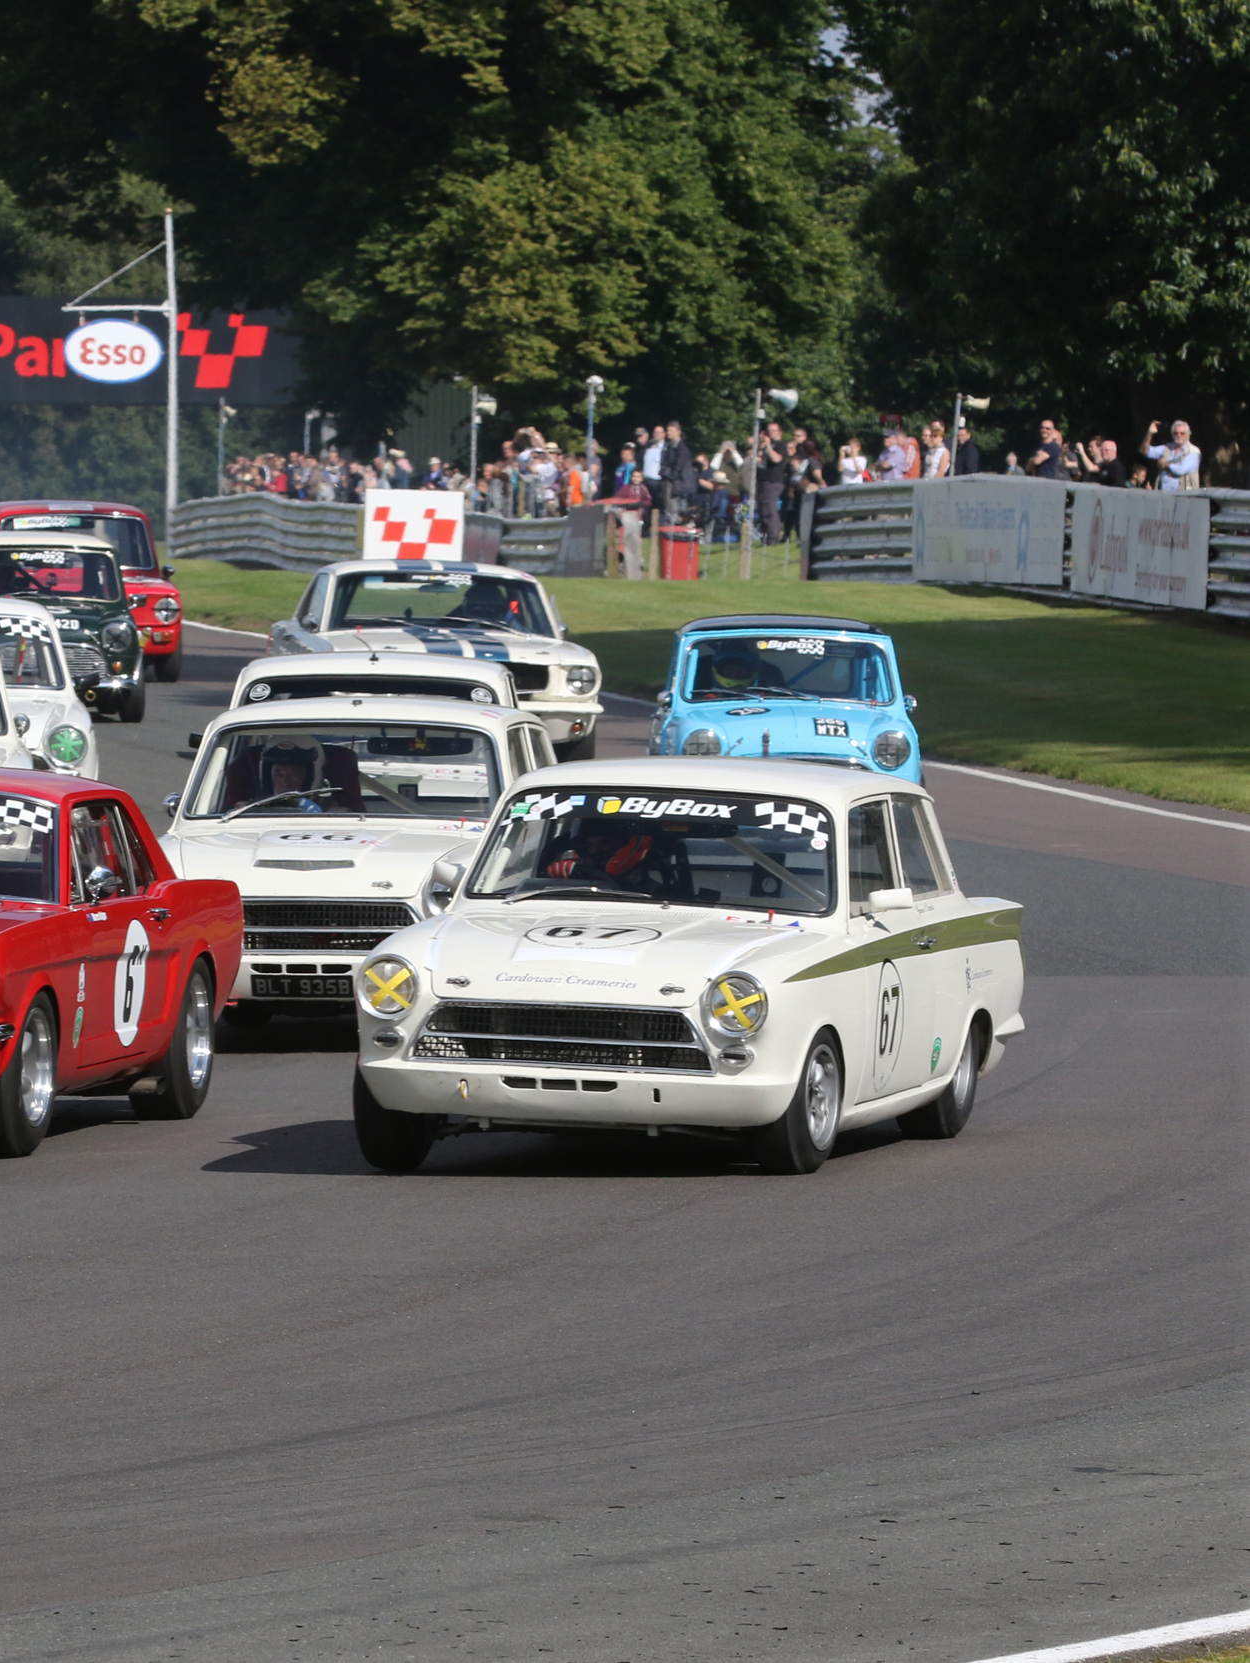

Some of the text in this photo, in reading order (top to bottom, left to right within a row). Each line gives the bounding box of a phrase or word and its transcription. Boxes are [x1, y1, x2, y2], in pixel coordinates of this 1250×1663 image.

[80, 337, 146, 366] Esso
[766, 640, 814, 651] ByBox
[620, 797, 738, 819] ByBox
[279, 833, 356, 842] 66
[546, 926, 637, 939] 67
[254, 978, 350, 994] BLT 935B
[566, 975, 638, 989] Creameries
[878, 982, 901, 1058] 67
